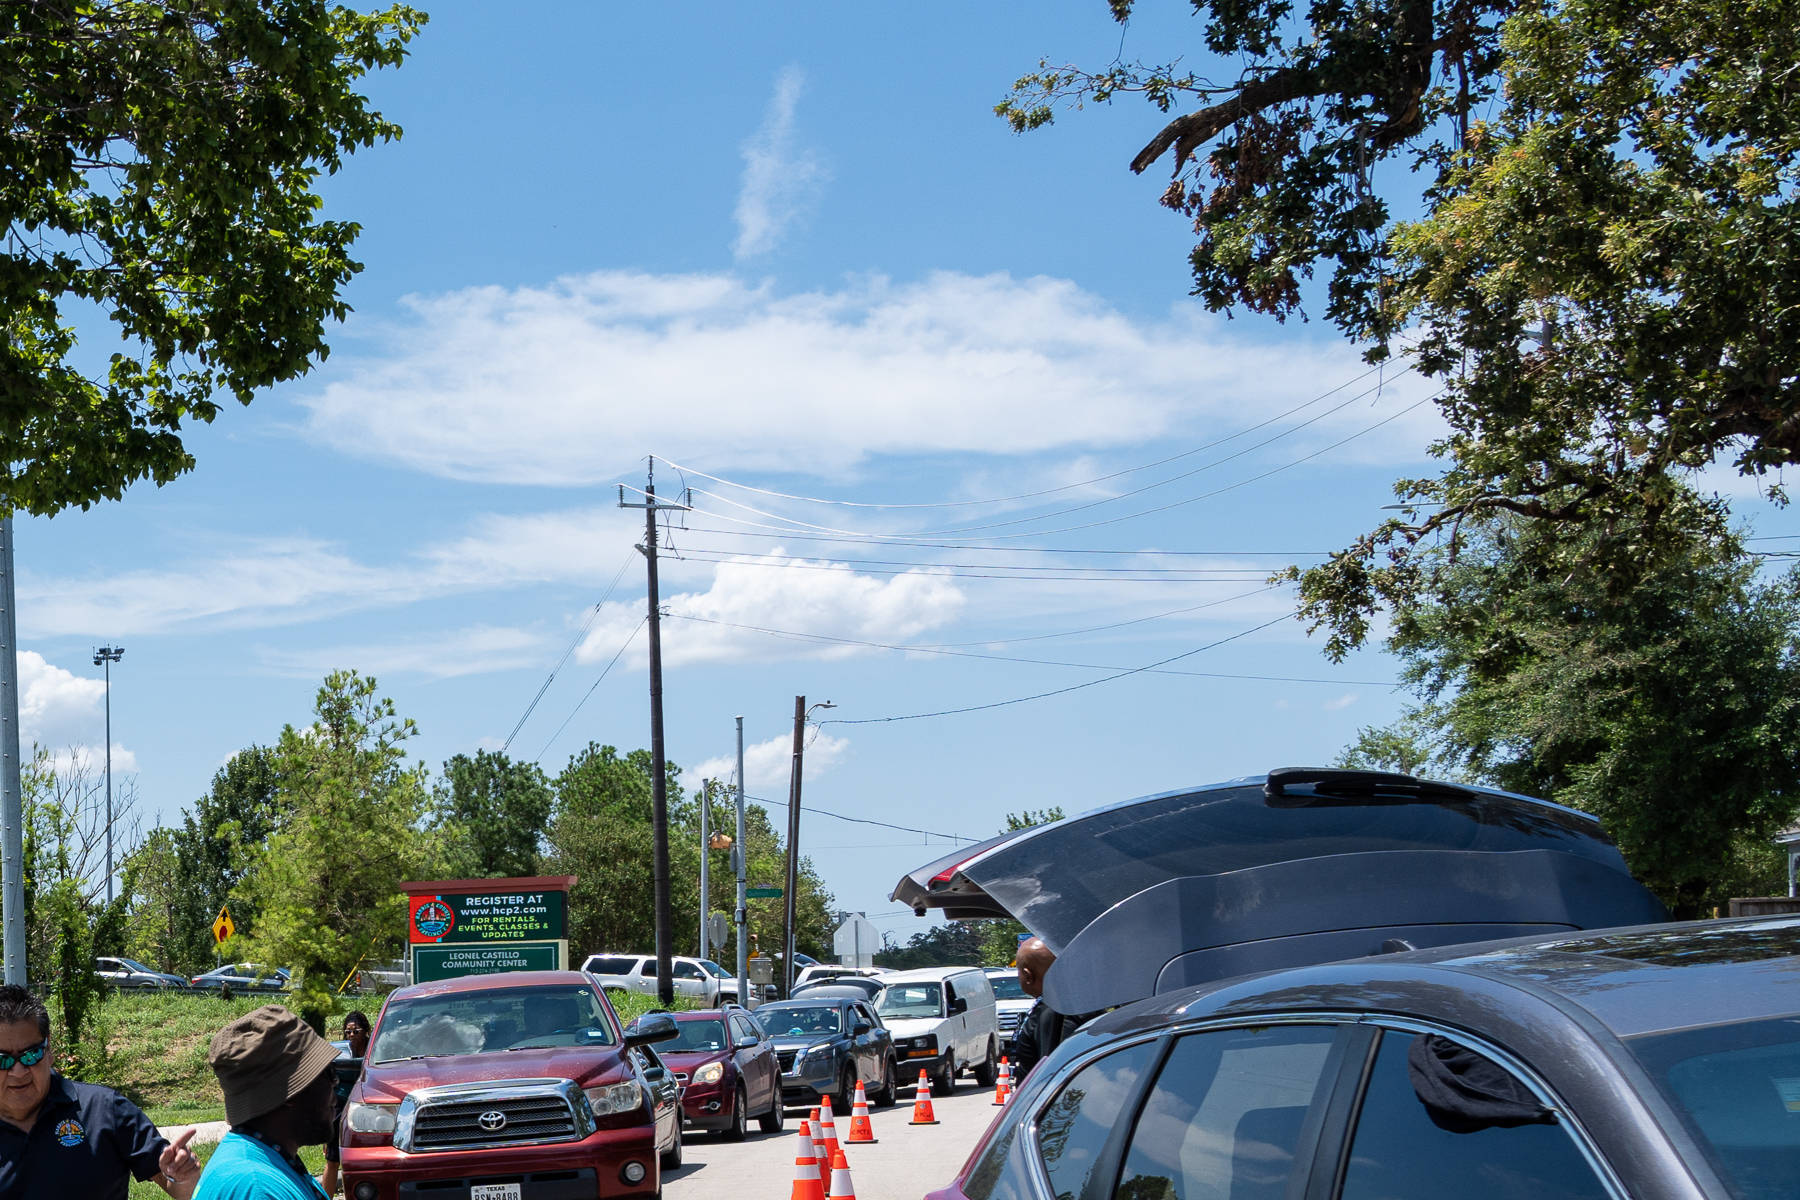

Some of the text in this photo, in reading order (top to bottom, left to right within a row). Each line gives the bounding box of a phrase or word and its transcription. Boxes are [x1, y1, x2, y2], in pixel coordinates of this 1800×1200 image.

[465, 895, 544, 906] REGISTER AT
[460, 906, 547, 916] www.hcp2.com
[499, 923, 540, 931] CLASSES
[481, 931, 525, 939] UPDATES
[449, 951, 520, 960] LEONEL CASTILLO
[442, 959, 528, 969] COMMUNITY CENTER
